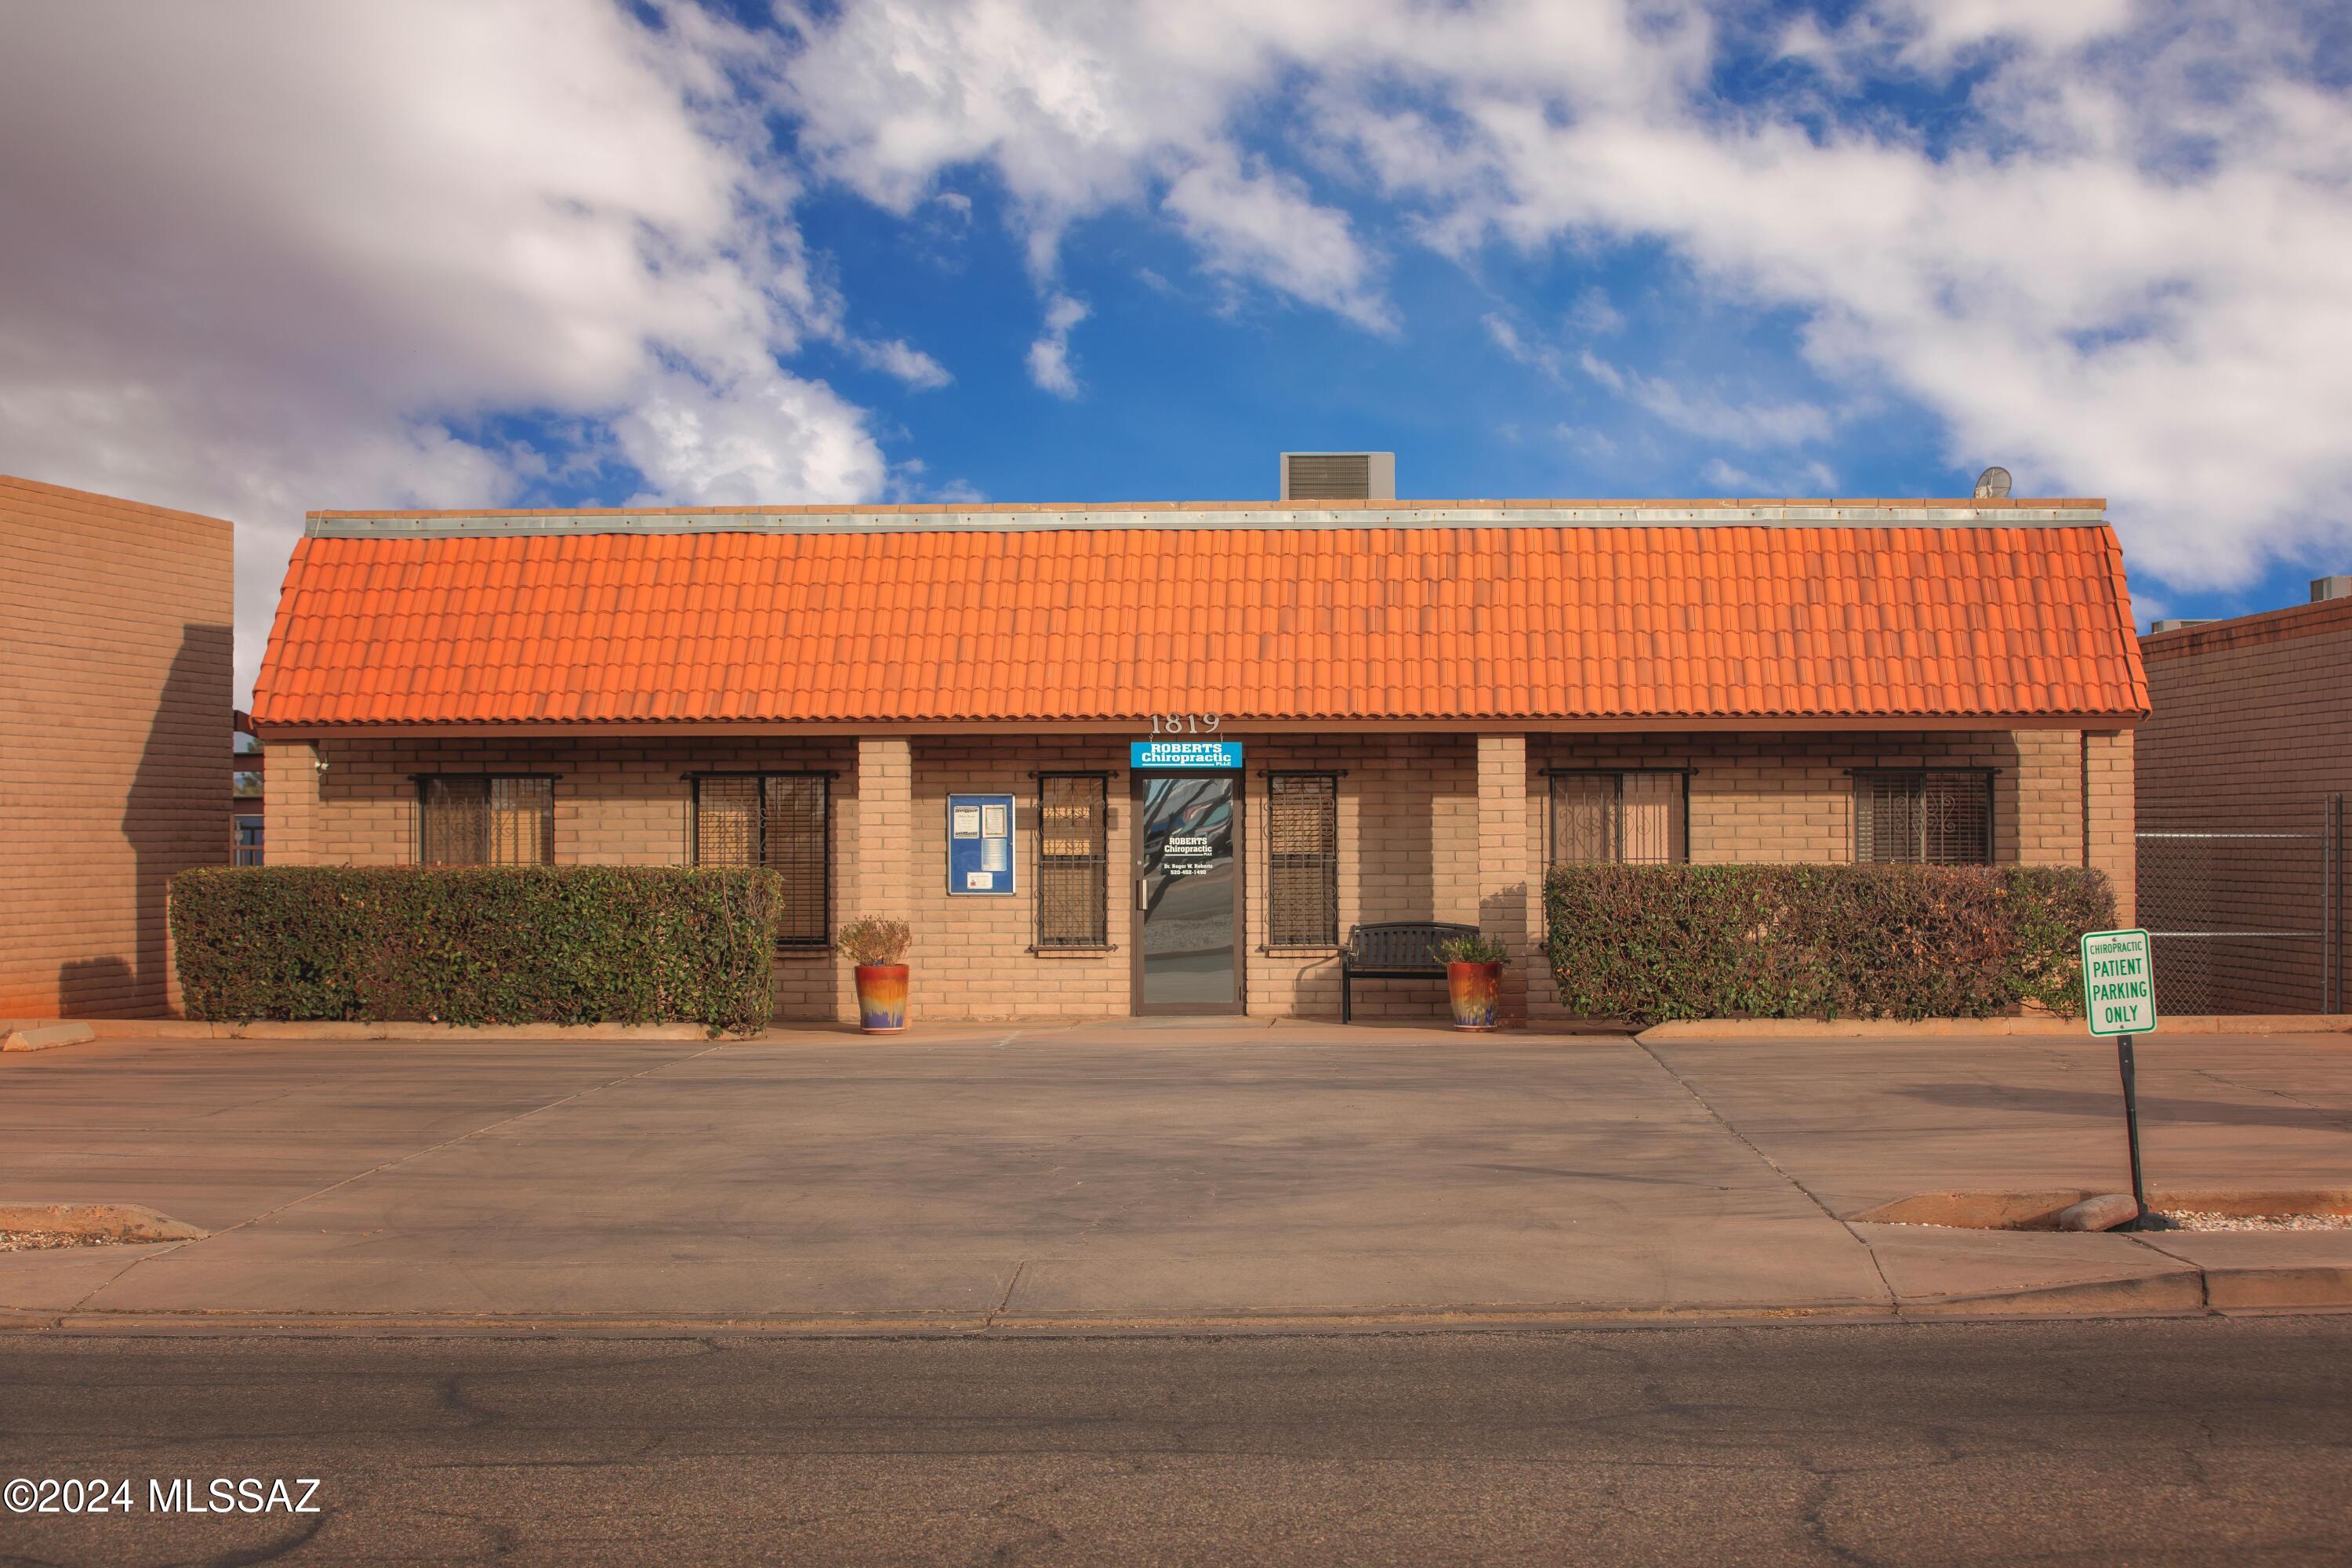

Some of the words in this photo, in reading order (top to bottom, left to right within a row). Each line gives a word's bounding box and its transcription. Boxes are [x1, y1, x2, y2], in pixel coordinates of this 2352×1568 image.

[1151, 713, 1220, 733] 1819
[1151, 743, 1222, 753] ROBERTS
[1142, 753, 1232, 764] Chiropractic
[1164, 845, 1212, 854] Chiropractic
[2089, 941, 2143, 955] CHIROPRACTIC
[2093, 958, 2142, 978] PATIENT
[2092, 981, 2147, 1001] PARKING
[2105, 1005, 2138, 1024] ONLY
